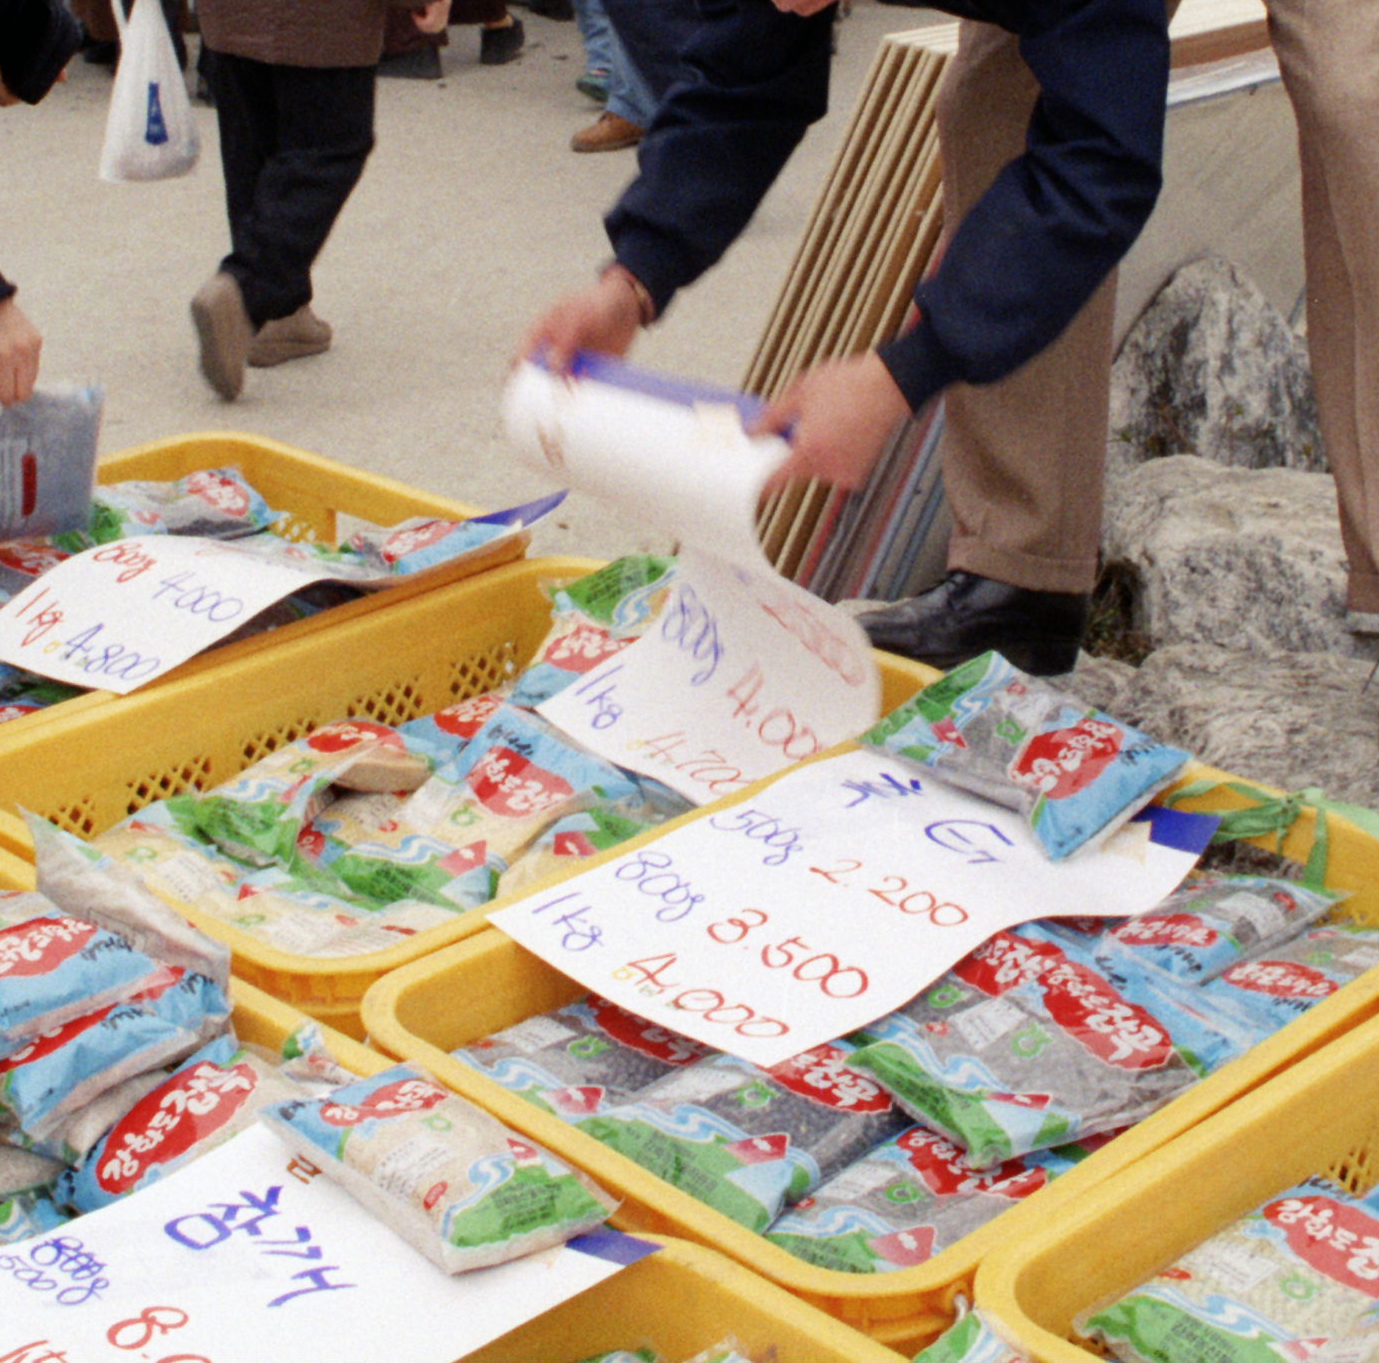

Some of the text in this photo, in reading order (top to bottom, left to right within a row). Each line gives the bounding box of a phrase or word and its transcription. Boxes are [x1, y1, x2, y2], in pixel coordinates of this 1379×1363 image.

[710, 809, 804, 866] 500g
[615, 851, 705, 923] 800g
[163, 1183, 358, 1310] 참깨
